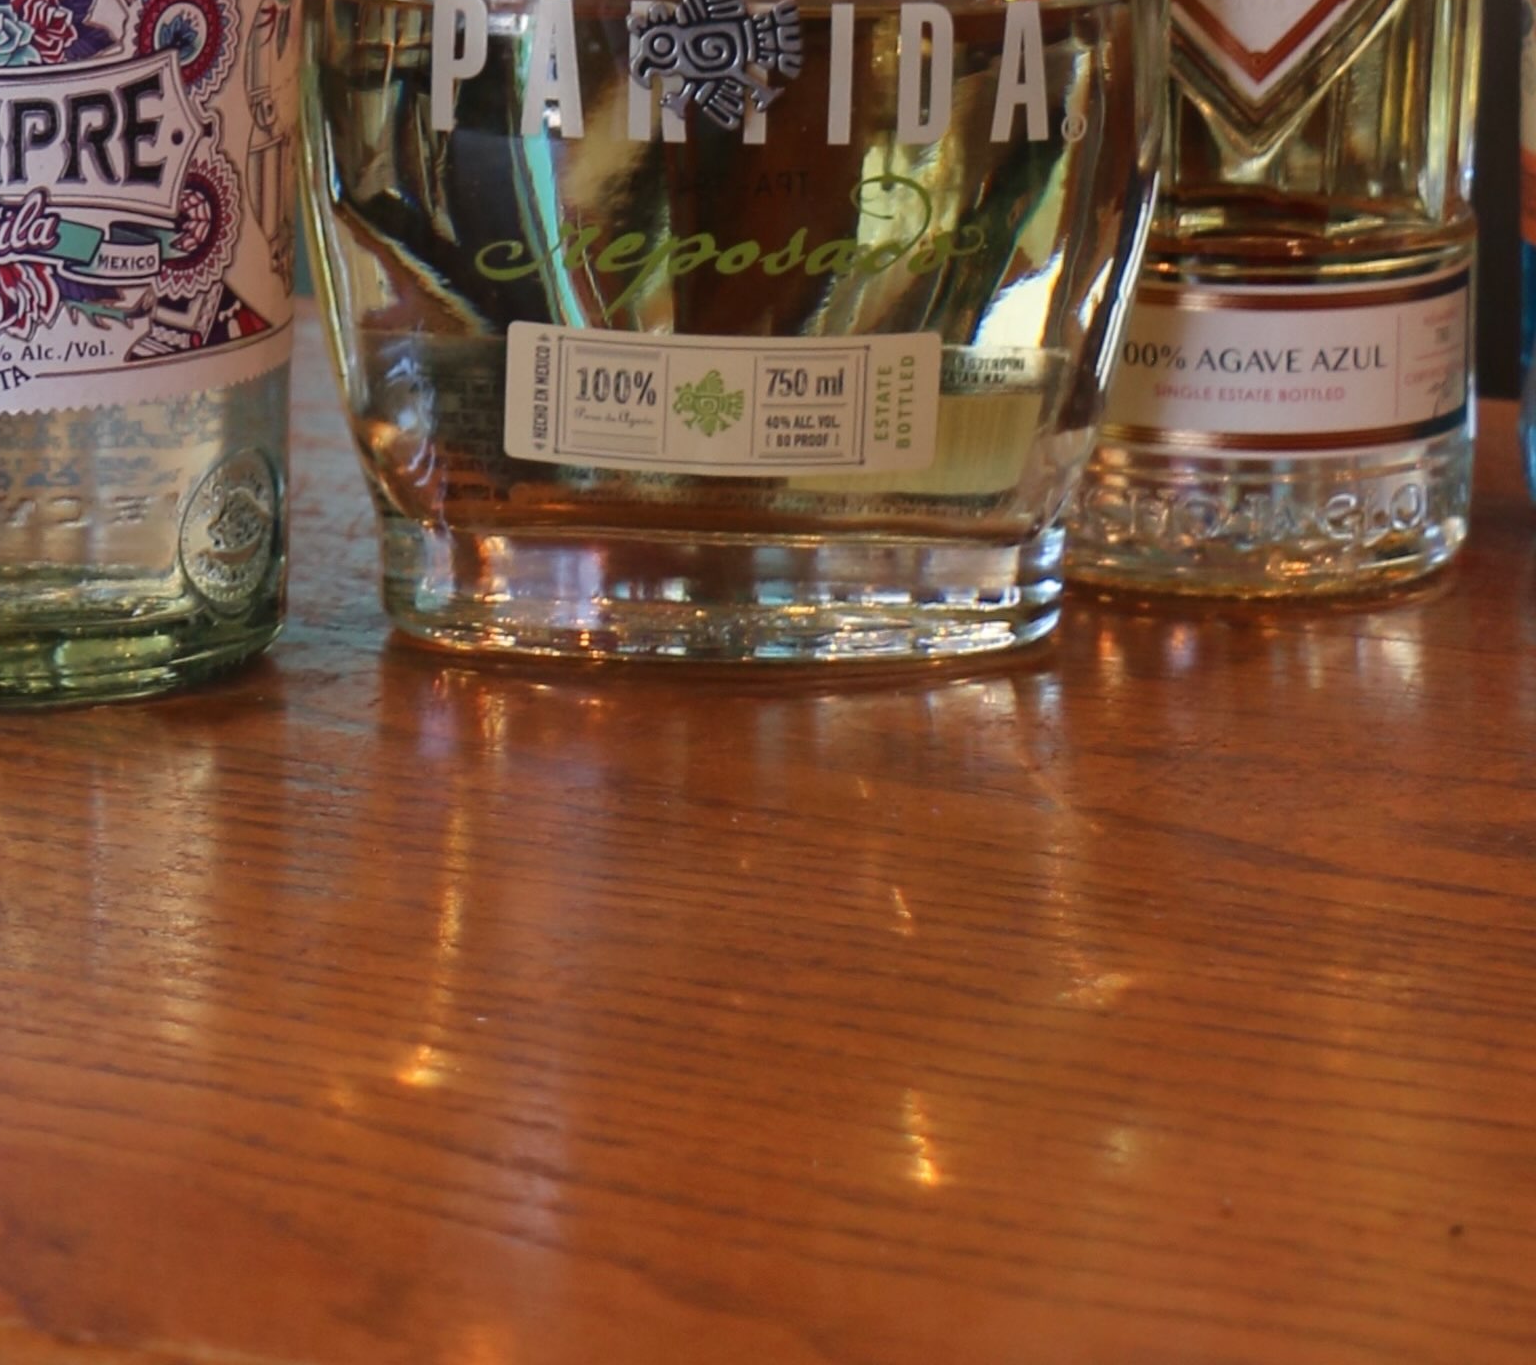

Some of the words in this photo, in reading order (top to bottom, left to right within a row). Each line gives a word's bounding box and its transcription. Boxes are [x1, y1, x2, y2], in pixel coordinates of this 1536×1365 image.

[96, 254, 157, 271] MEXICO
[1122, 342, 1187, 371] 00%
[1197, 346, 1303, 374] AGAVE
[1310, 344, 1388, 372] AZUL
[575, 366, 657, 407] 100%
[765, 368, 808, 397] 750
[815, 366, 845, 396] ml
[1153, 382, 1213, 402] SINGLE
[1217, 386, 1273, 403] ESTATE
[1277, 385, 1346, 403] BOTTLED
[873, 364, 892, 442] ESTATE
[895, 354, 915, 450] BOTTLED
